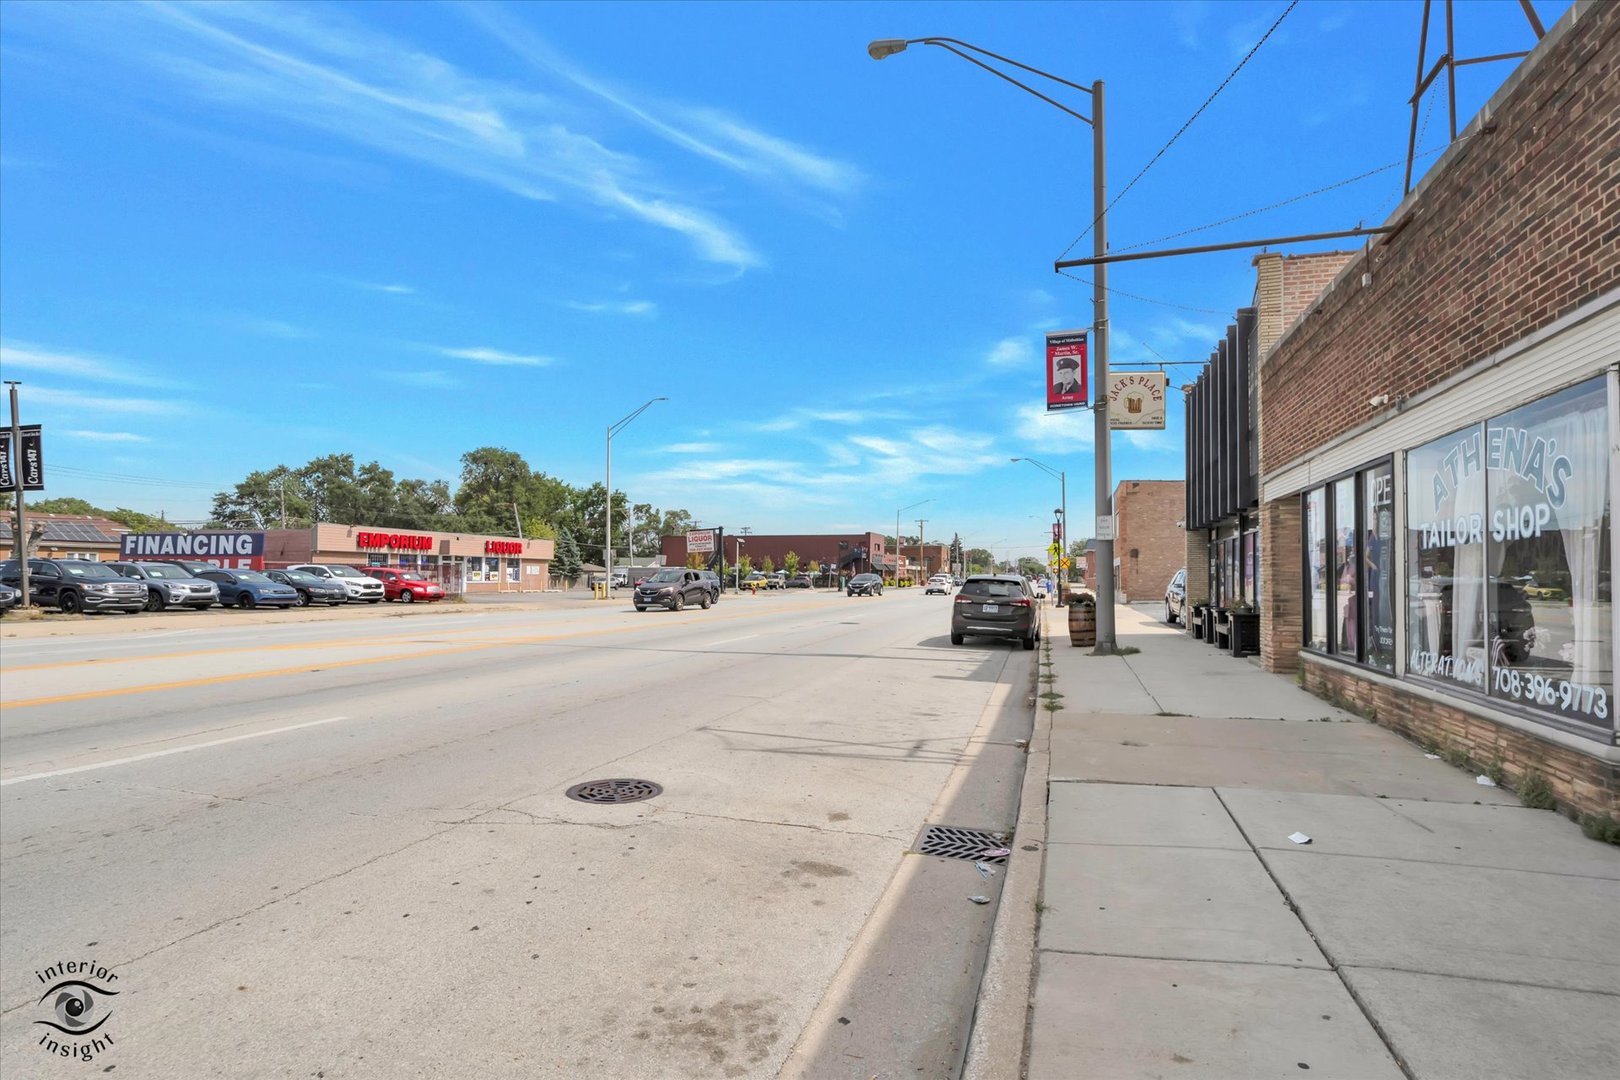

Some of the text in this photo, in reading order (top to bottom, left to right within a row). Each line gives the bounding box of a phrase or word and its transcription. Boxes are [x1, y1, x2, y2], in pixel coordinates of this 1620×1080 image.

[1110, 376, 1163, 402] JACK'S PLACE
[1432, 427, 1573, 516] ATHENA'S
[1420, 514, 1483, 550] TAILOR
[1492, 503, 1551, 543] SHOP
[125, 534, 253, 555] FINANCING
[358, 532, 432, 550] EMPORIUM
[485, 540, 522, 554] LIQUOR
[688, 535, 712, 543] LIQUOR
